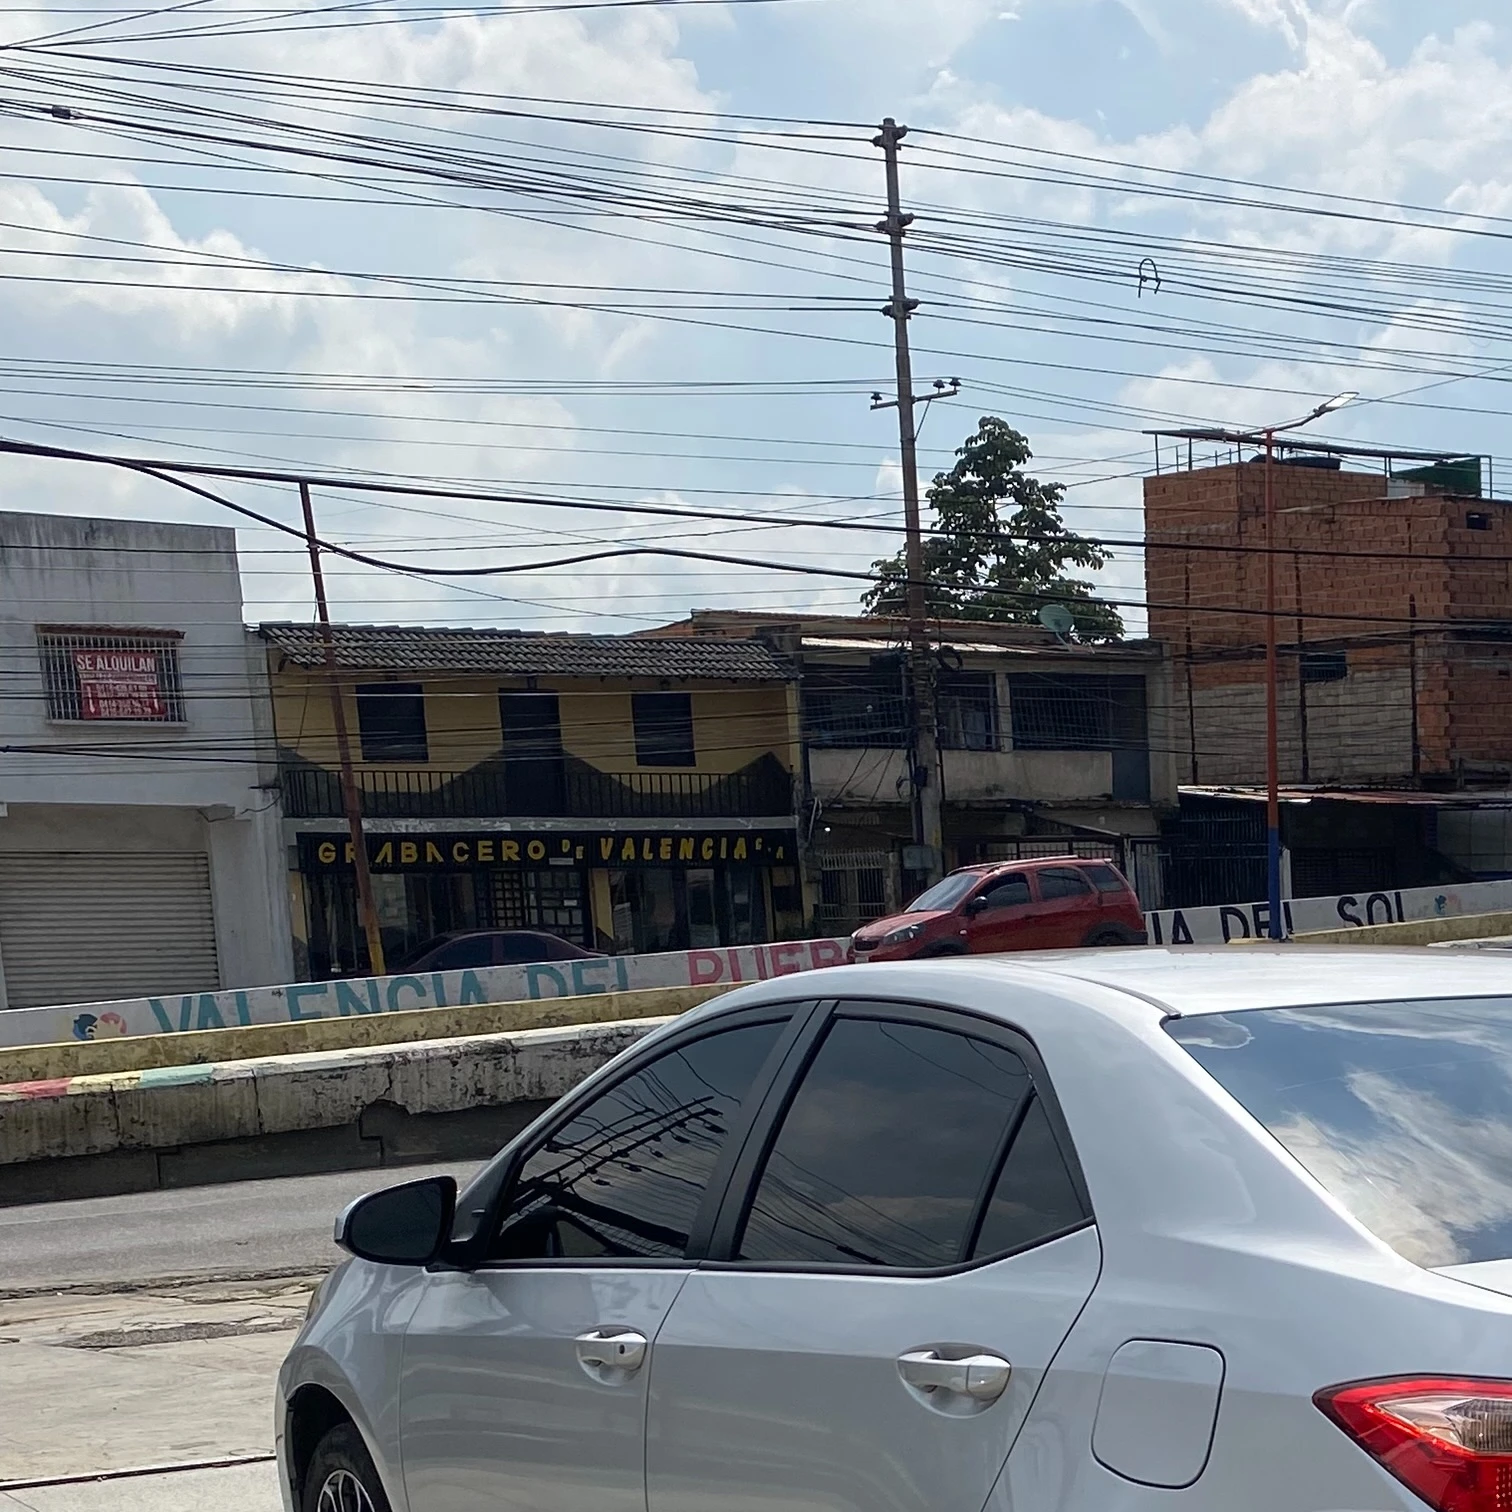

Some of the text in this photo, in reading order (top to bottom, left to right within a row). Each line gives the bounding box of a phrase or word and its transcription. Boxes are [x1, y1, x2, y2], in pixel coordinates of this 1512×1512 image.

[77, 654, 156, 673] SE ALQUILAN
[561, 838, 585, 860] DE
[600, 836, 748, 861] VALENCIA
